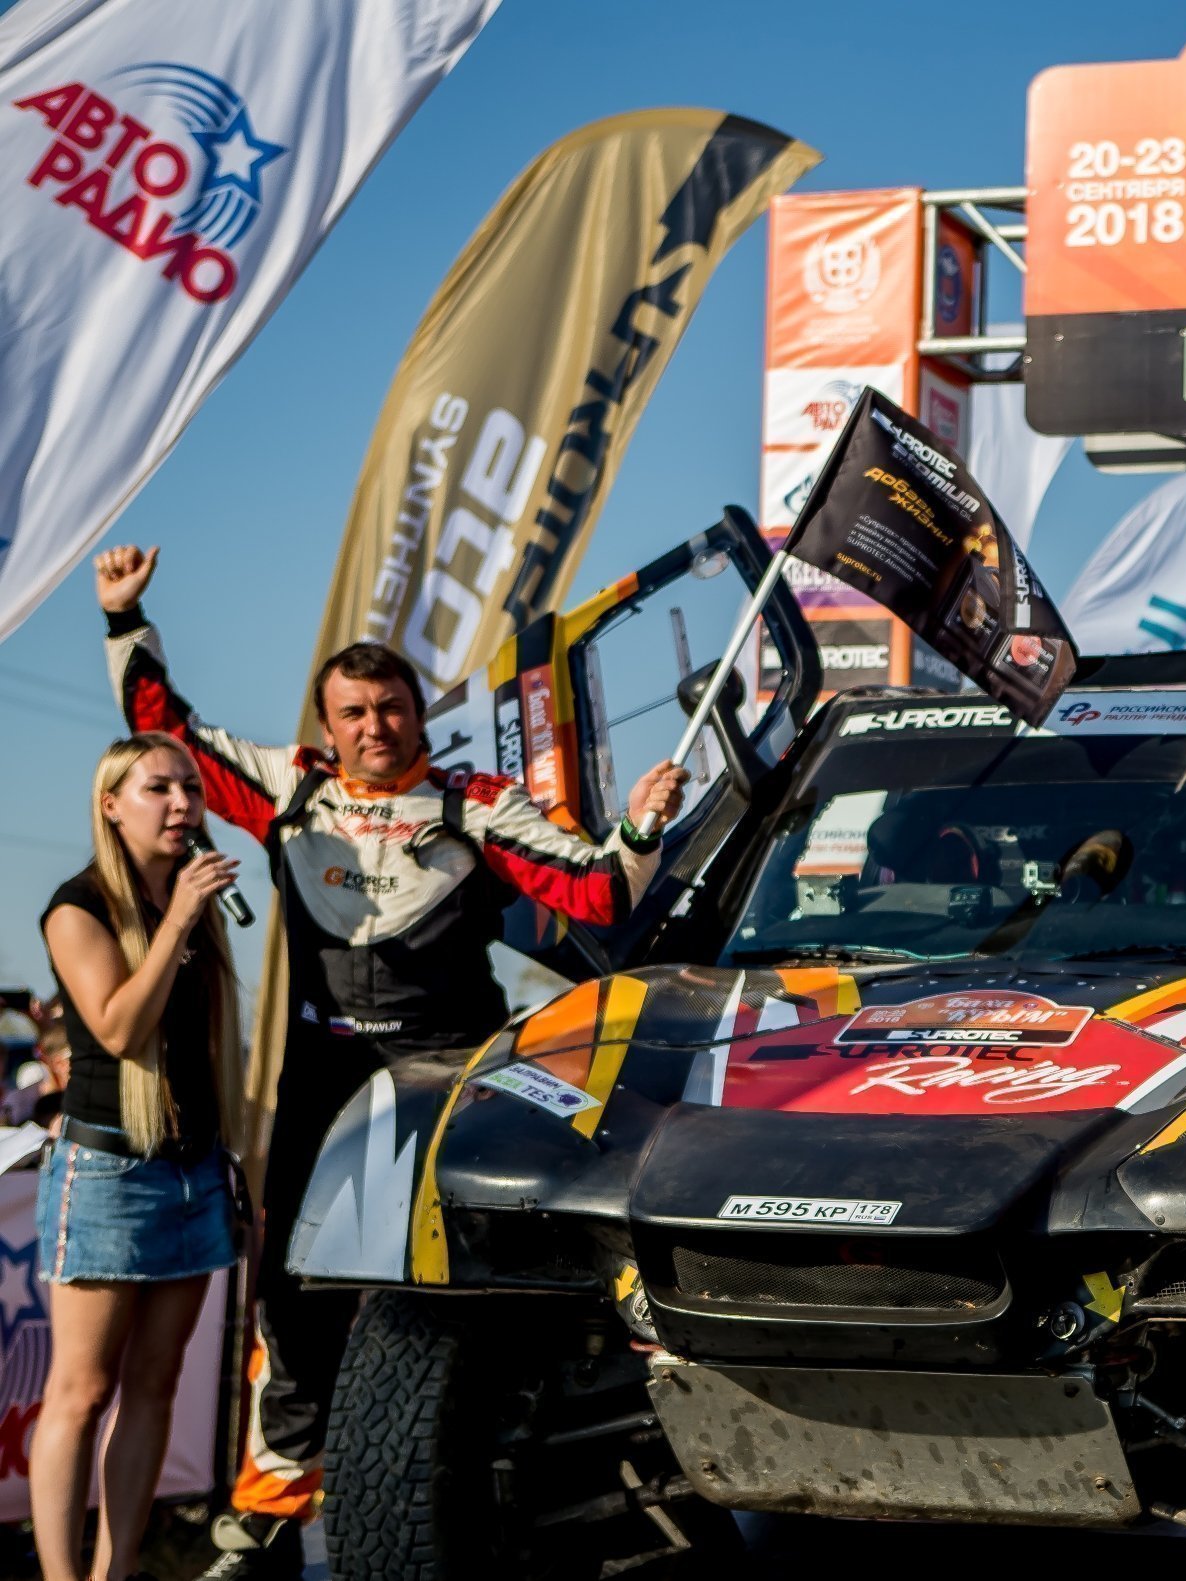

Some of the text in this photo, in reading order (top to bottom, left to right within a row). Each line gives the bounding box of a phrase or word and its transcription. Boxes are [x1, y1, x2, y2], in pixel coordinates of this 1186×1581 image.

[13, 82, 190, 198] АВТО
[1068, 138, 1186, 178] 20-23
[1066, 178, 1186, 201] СЕНТЯБРЯ
[27, 138, 238, 304] РАДИО
[1065, 201, 1184, 247] 2018
[880, 412, 957, 479] SUPROTEC
[864, 704, 1013, 732] SUPROTEC
[906, 1029, 1023, 1041] SUPROTEC
[848, 1055, 1122, 1105] Racing
[755, 1201, 813, 1217] 595
[859, 1204, 892, 1215] 178
